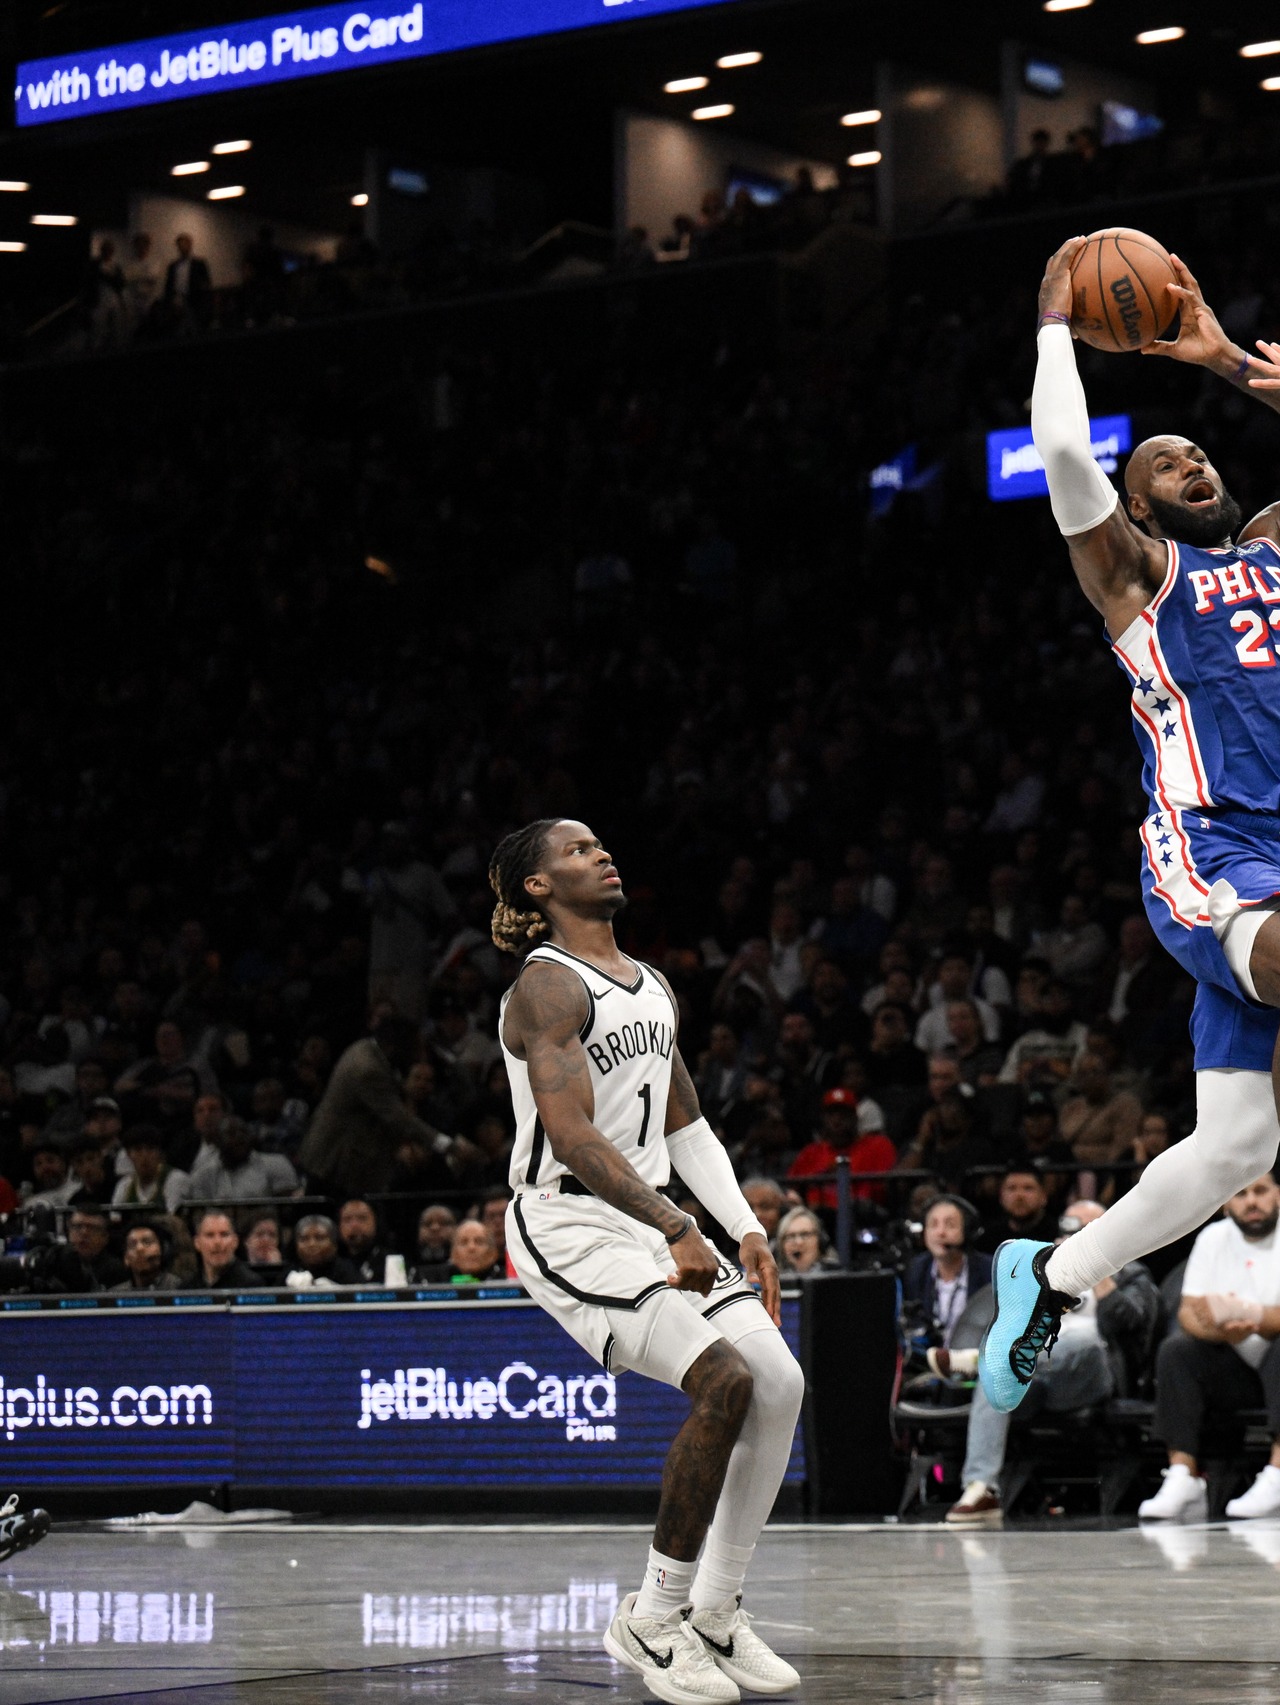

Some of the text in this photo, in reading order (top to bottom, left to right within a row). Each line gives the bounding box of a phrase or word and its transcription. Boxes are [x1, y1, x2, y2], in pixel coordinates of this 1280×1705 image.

[27, 3, 424, 110] with the JetBlue Plus Card
[1110, 274, 1143, 346] Wilson
[586, 1020, 675, 1076] BROOKLY
[637, 1083, 651, 1148] 1
[357, 1361, 617, 1430] jetBlueCard
